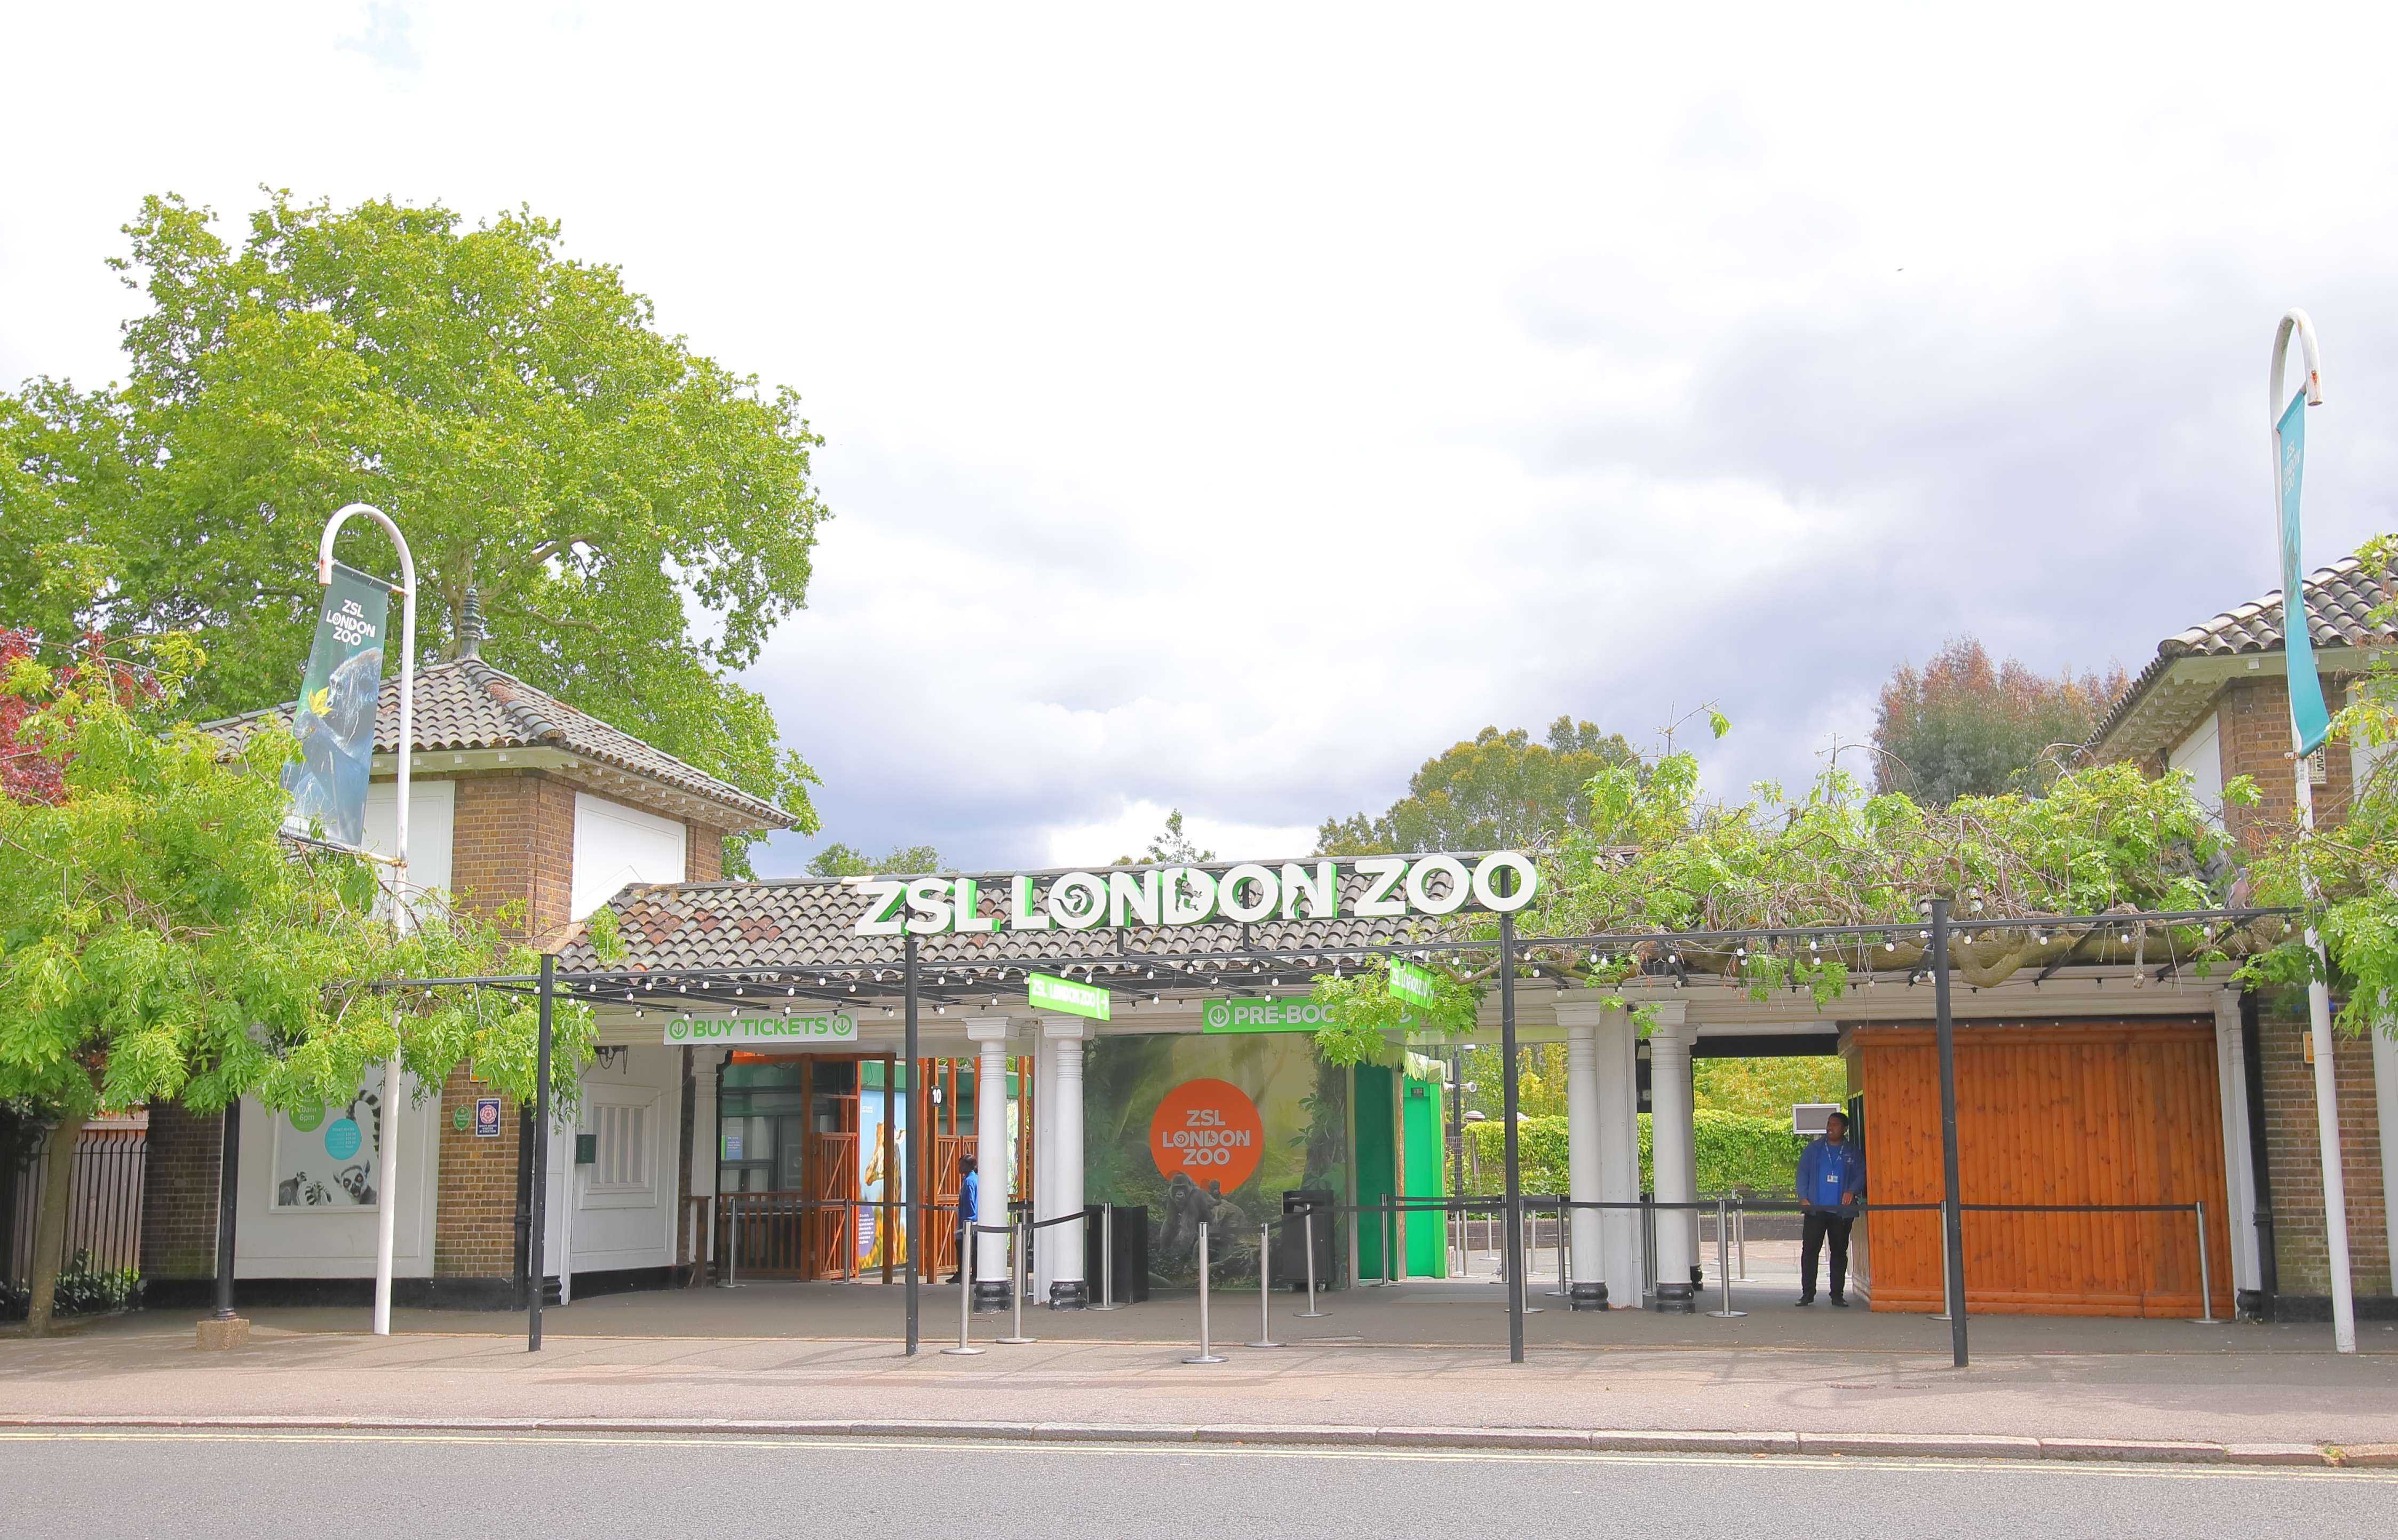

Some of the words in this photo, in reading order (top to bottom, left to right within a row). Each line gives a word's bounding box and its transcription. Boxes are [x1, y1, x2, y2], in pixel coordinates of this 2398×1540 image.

[342, 599, 364, 618] ZSL
[325, 609, 376, 638] LONDON
[332, 626, 361, 646] ZOO
[855, 878, 998, 937] ZSL
[1012, 861, 1338, 931] LONDON
[1353, 852, 1539, 917] ZOO
[1032, 979, 1047, 997] ZSL
[1050, 982, 1080, 1004] LONDON
[1080, 989, 1096, 1007] ZOO
[694, 1020, 736, 1038] BUY
[740, 1017, 828, 1036] TICKETS
[933, 1089, 942, 1104] 10
[299, 1114, 315, 1122] 6pm
[1187, 1109, 1226, 1126] ZSL
[1163, 1130, 1250, 1147] LONDON
[1183, 1148, 1230, 1165] ZOO
